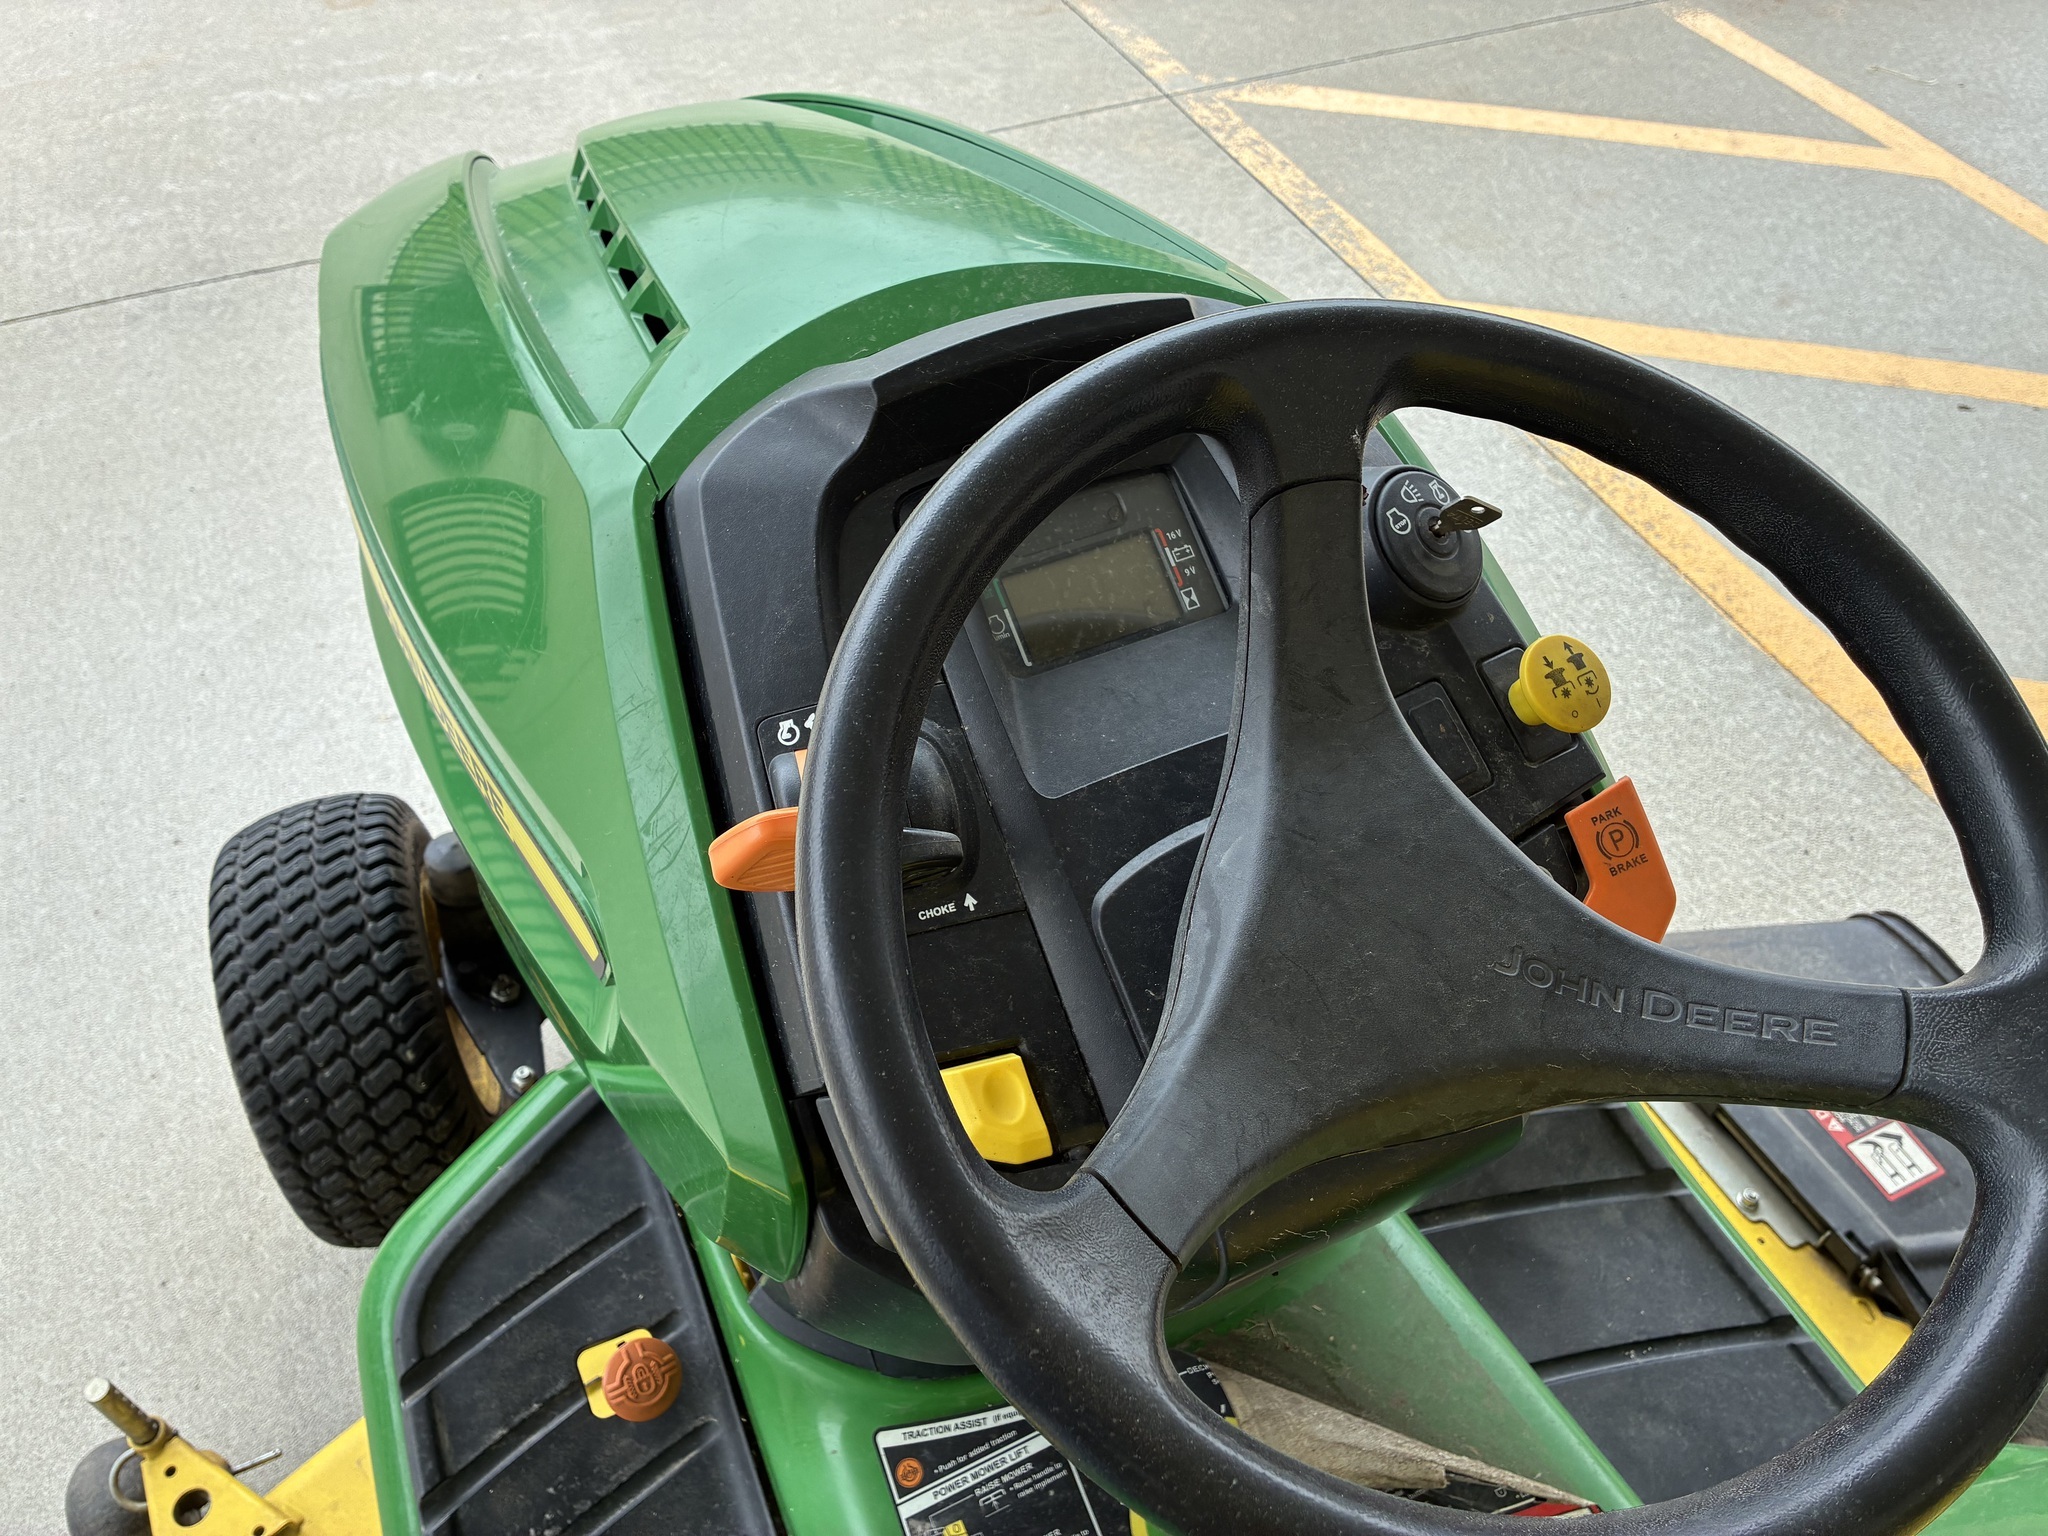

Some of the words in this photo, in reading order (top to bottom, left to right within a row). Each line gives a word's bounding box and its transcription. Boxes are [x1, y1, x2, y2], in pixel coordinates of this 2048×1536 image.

[1394, 518, 1407, 530] STOP
[1590, 806, 1622, 826] PARK
[1608, 828, 1624, 852] P
[1608, 853, 1648, 877] BRAKE
[918, 902, 957, 921] CHOKE
[1494, 944, 1625, 1013] JOHN
[1641, 988, 1840, 1046] DEERE
[901, 1424, 952, 1441] TRACTION
[953, 1416, 988, 1432] ASSIST
[940, 1458, 958, 1473] Push
[956, 1453, 968, 1464] for
[968, 1442, 990, 1458] added
[990, 1430, 1018, 1448] traction
[932, 1476, 970, 1500] POWER
[970, 1456, 1008, 1481] MOWER
[1010, 1446, 1030, 1462] LIFT
[974, 1478, 1001, 1498] RAISE
[1000, 1462, 1034, 1484] MOWER
